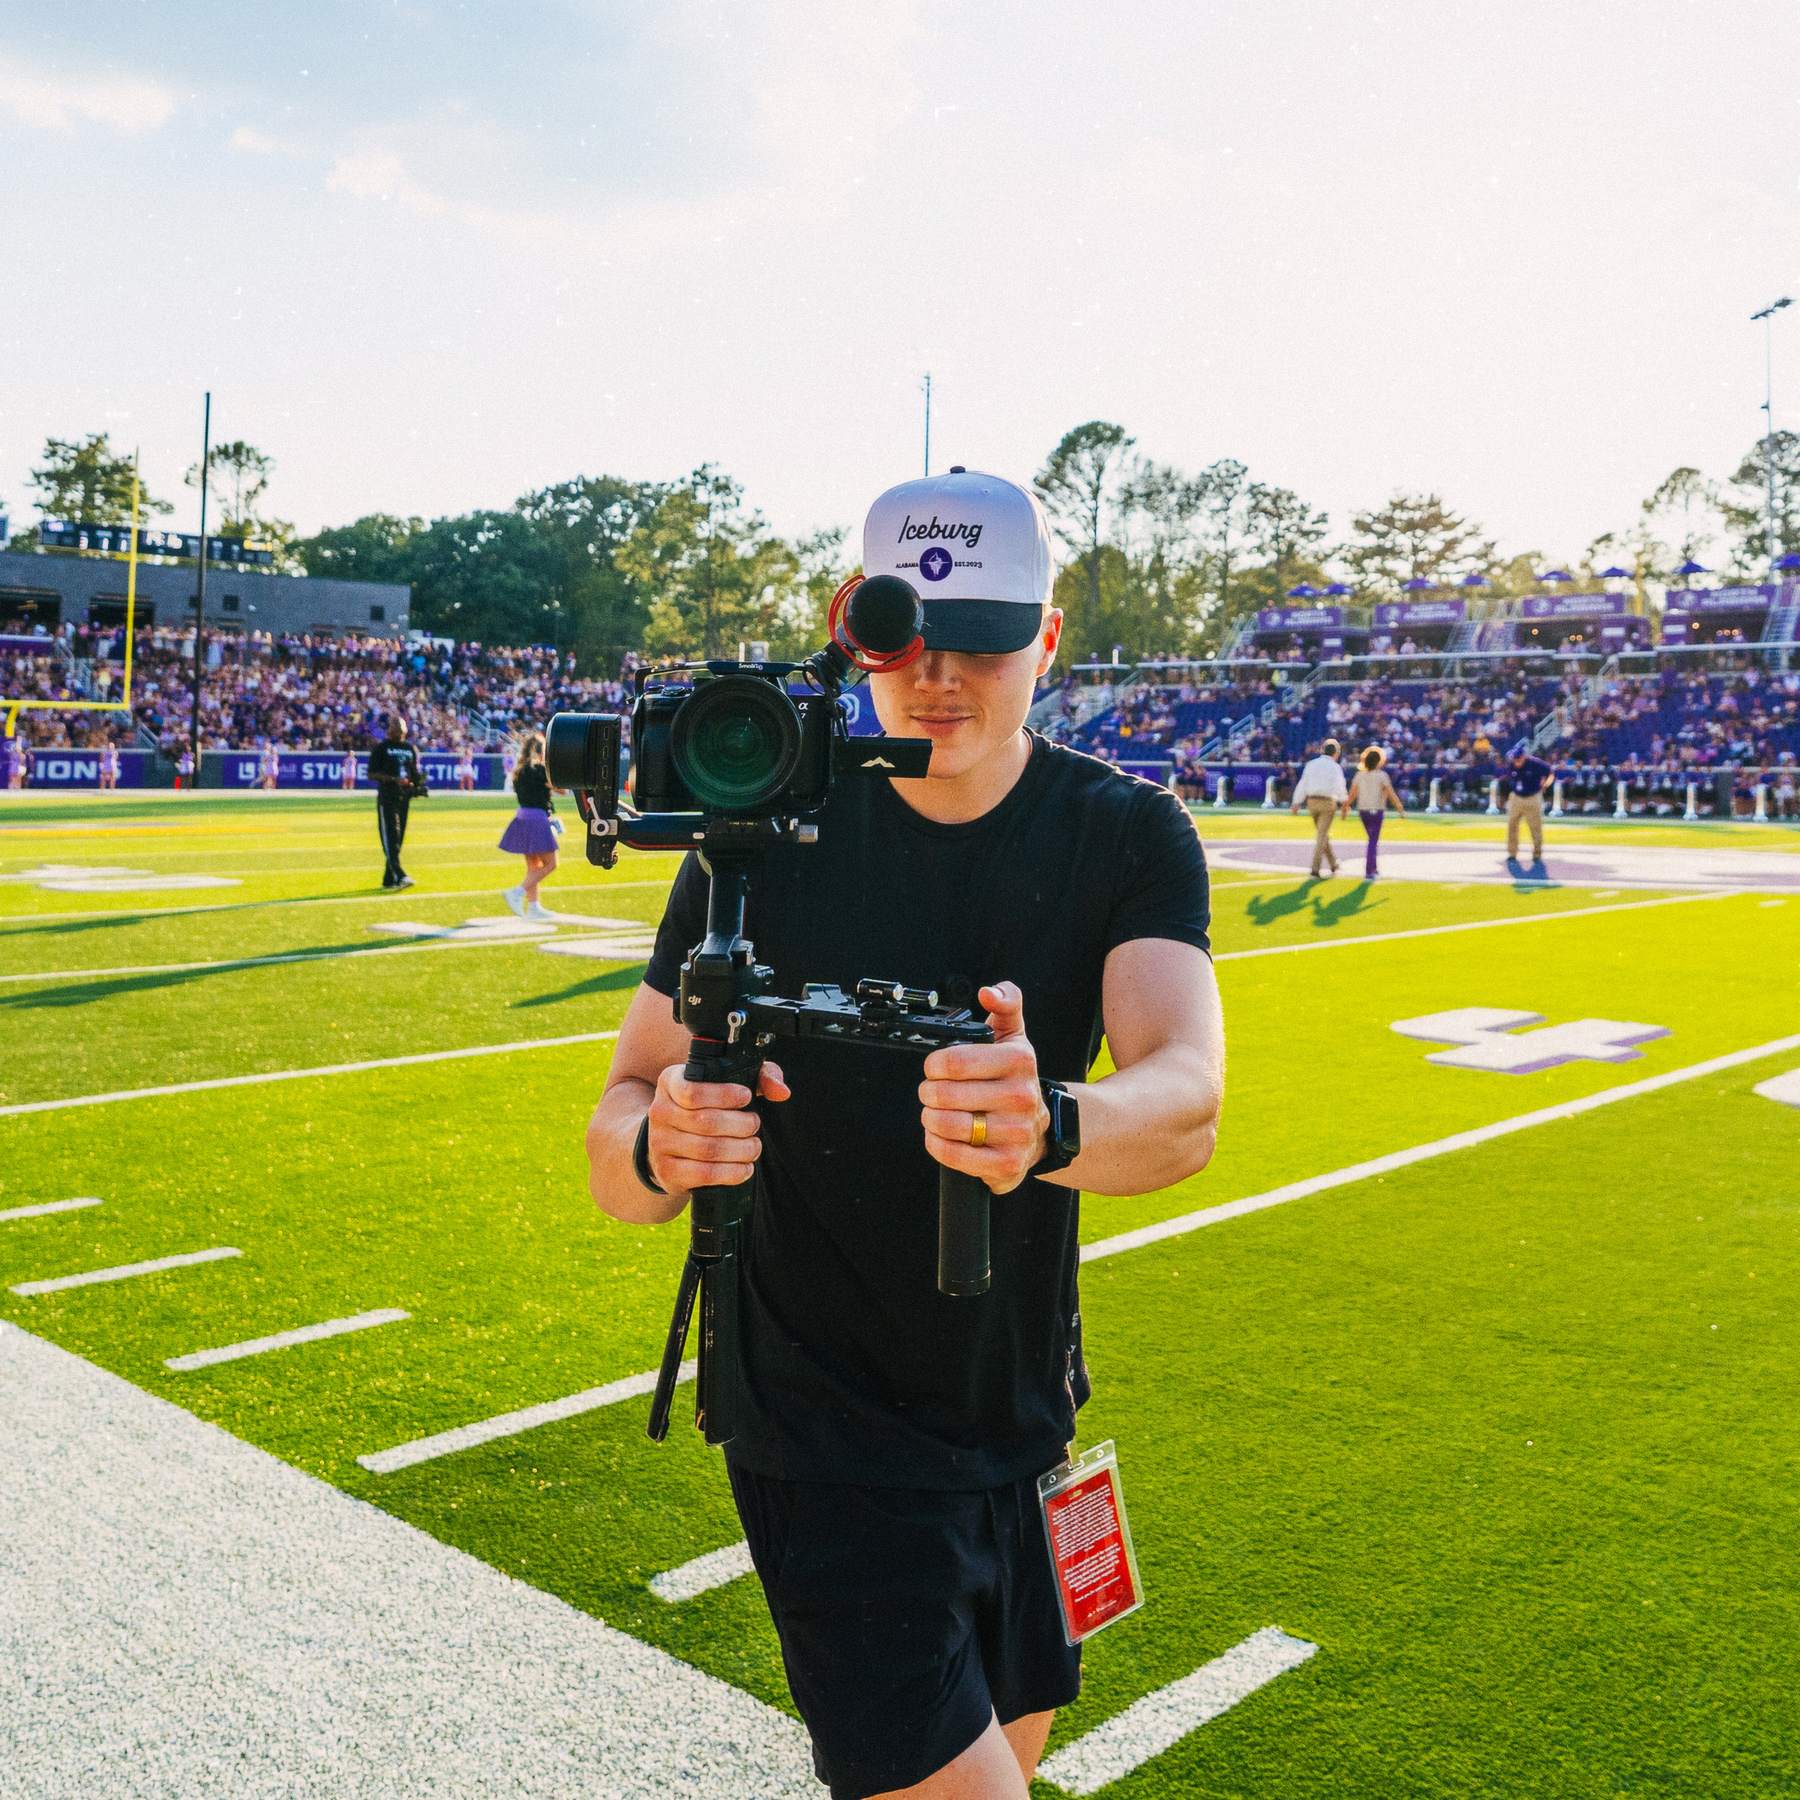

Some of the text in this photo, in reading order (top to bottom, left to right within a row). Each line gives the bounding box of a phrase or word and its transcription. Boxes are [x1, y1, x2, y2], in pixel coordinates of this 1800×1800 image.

[898, 515, 984, 548] Iceburg
[28, 760, 122, 780] ION
[687, 994, 702, 1006] dji
